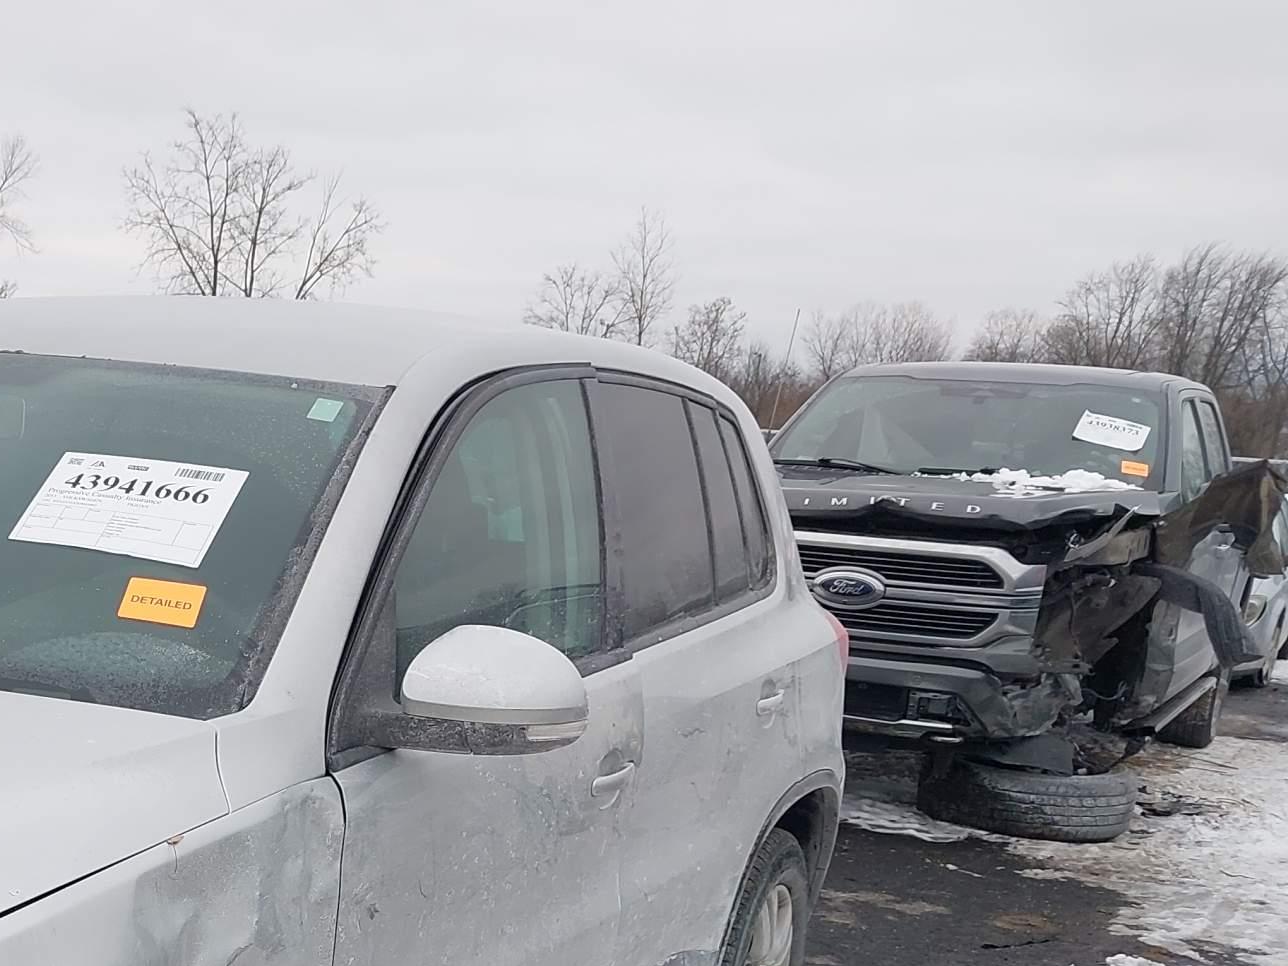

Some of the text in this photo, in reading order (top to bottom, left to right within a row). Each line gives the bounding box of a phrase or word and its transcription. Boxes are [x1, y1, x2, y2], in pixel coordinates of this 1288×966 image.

[48, 487, 90, 497] Progressive
[125, 494, 162, 505] Insurance
[65, 473, 215, 504] 43941666
[804, 495, 982, 513] IMITED
[829, 578, 863, 596] Ford
[130, 594, 192, 610] DETAILED
